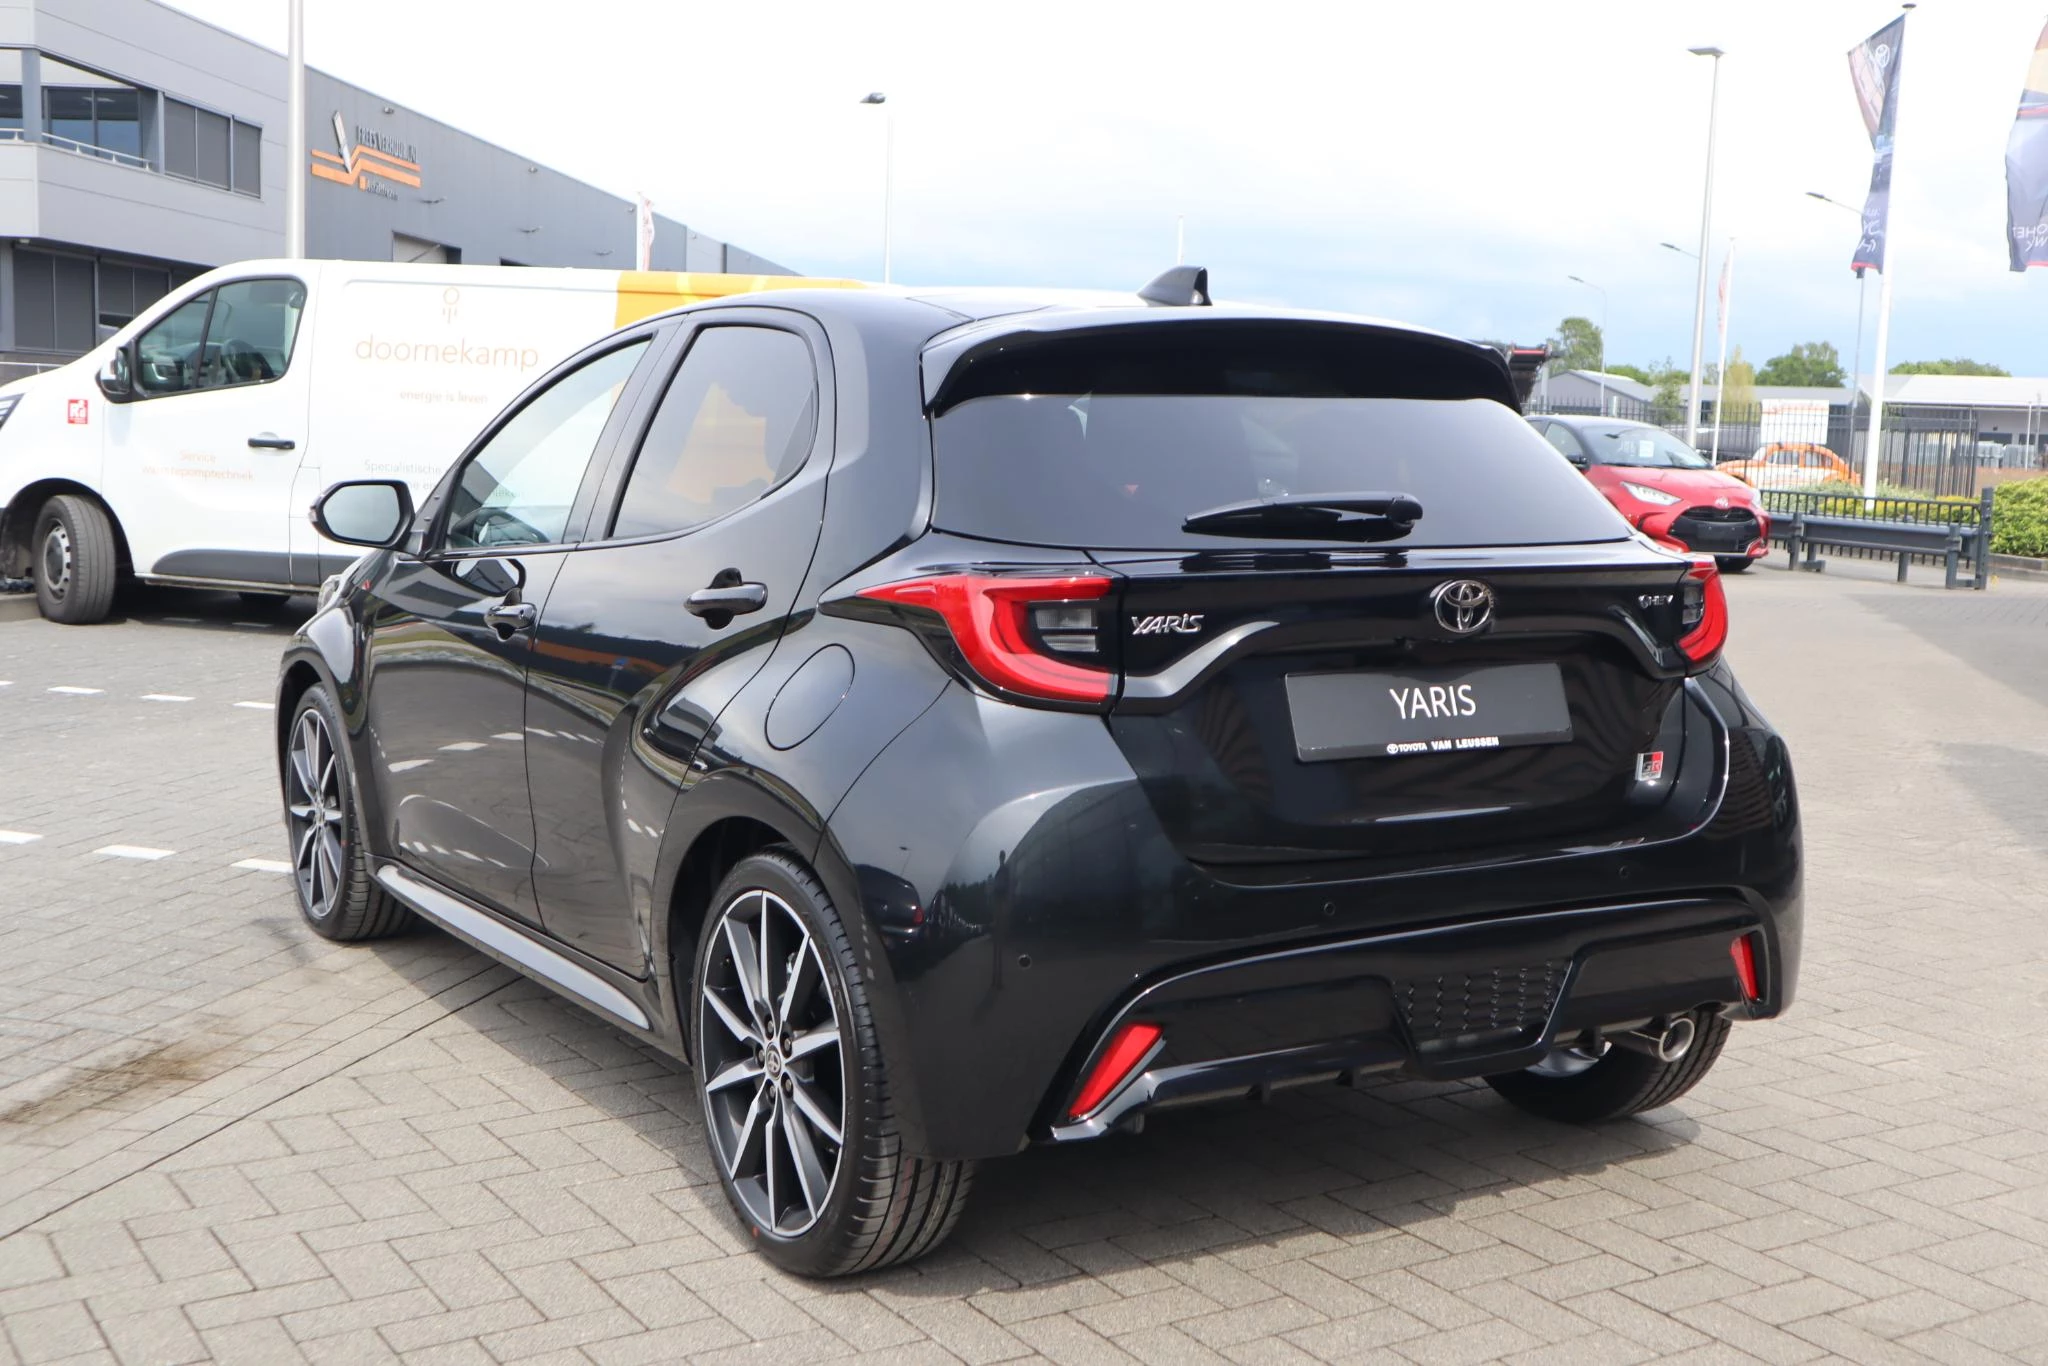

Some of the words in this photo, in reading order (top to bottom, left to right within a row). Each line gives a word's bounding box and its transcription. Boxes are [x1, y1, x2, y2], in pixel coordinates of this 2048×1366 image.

[356, 333, 539, 373] doornekamp
[400, 389, 442, 404] energie
[446, 391, 455, 402] is
[458, 391, 488, 405] leven
[1389, 684, 1476, 720] YARIS
[1399, 742, 1428, 753] TOYOTA
[1431, 740, 1452, 751] VAN
[1456, 736, 1499, 749] LEUSSEN
